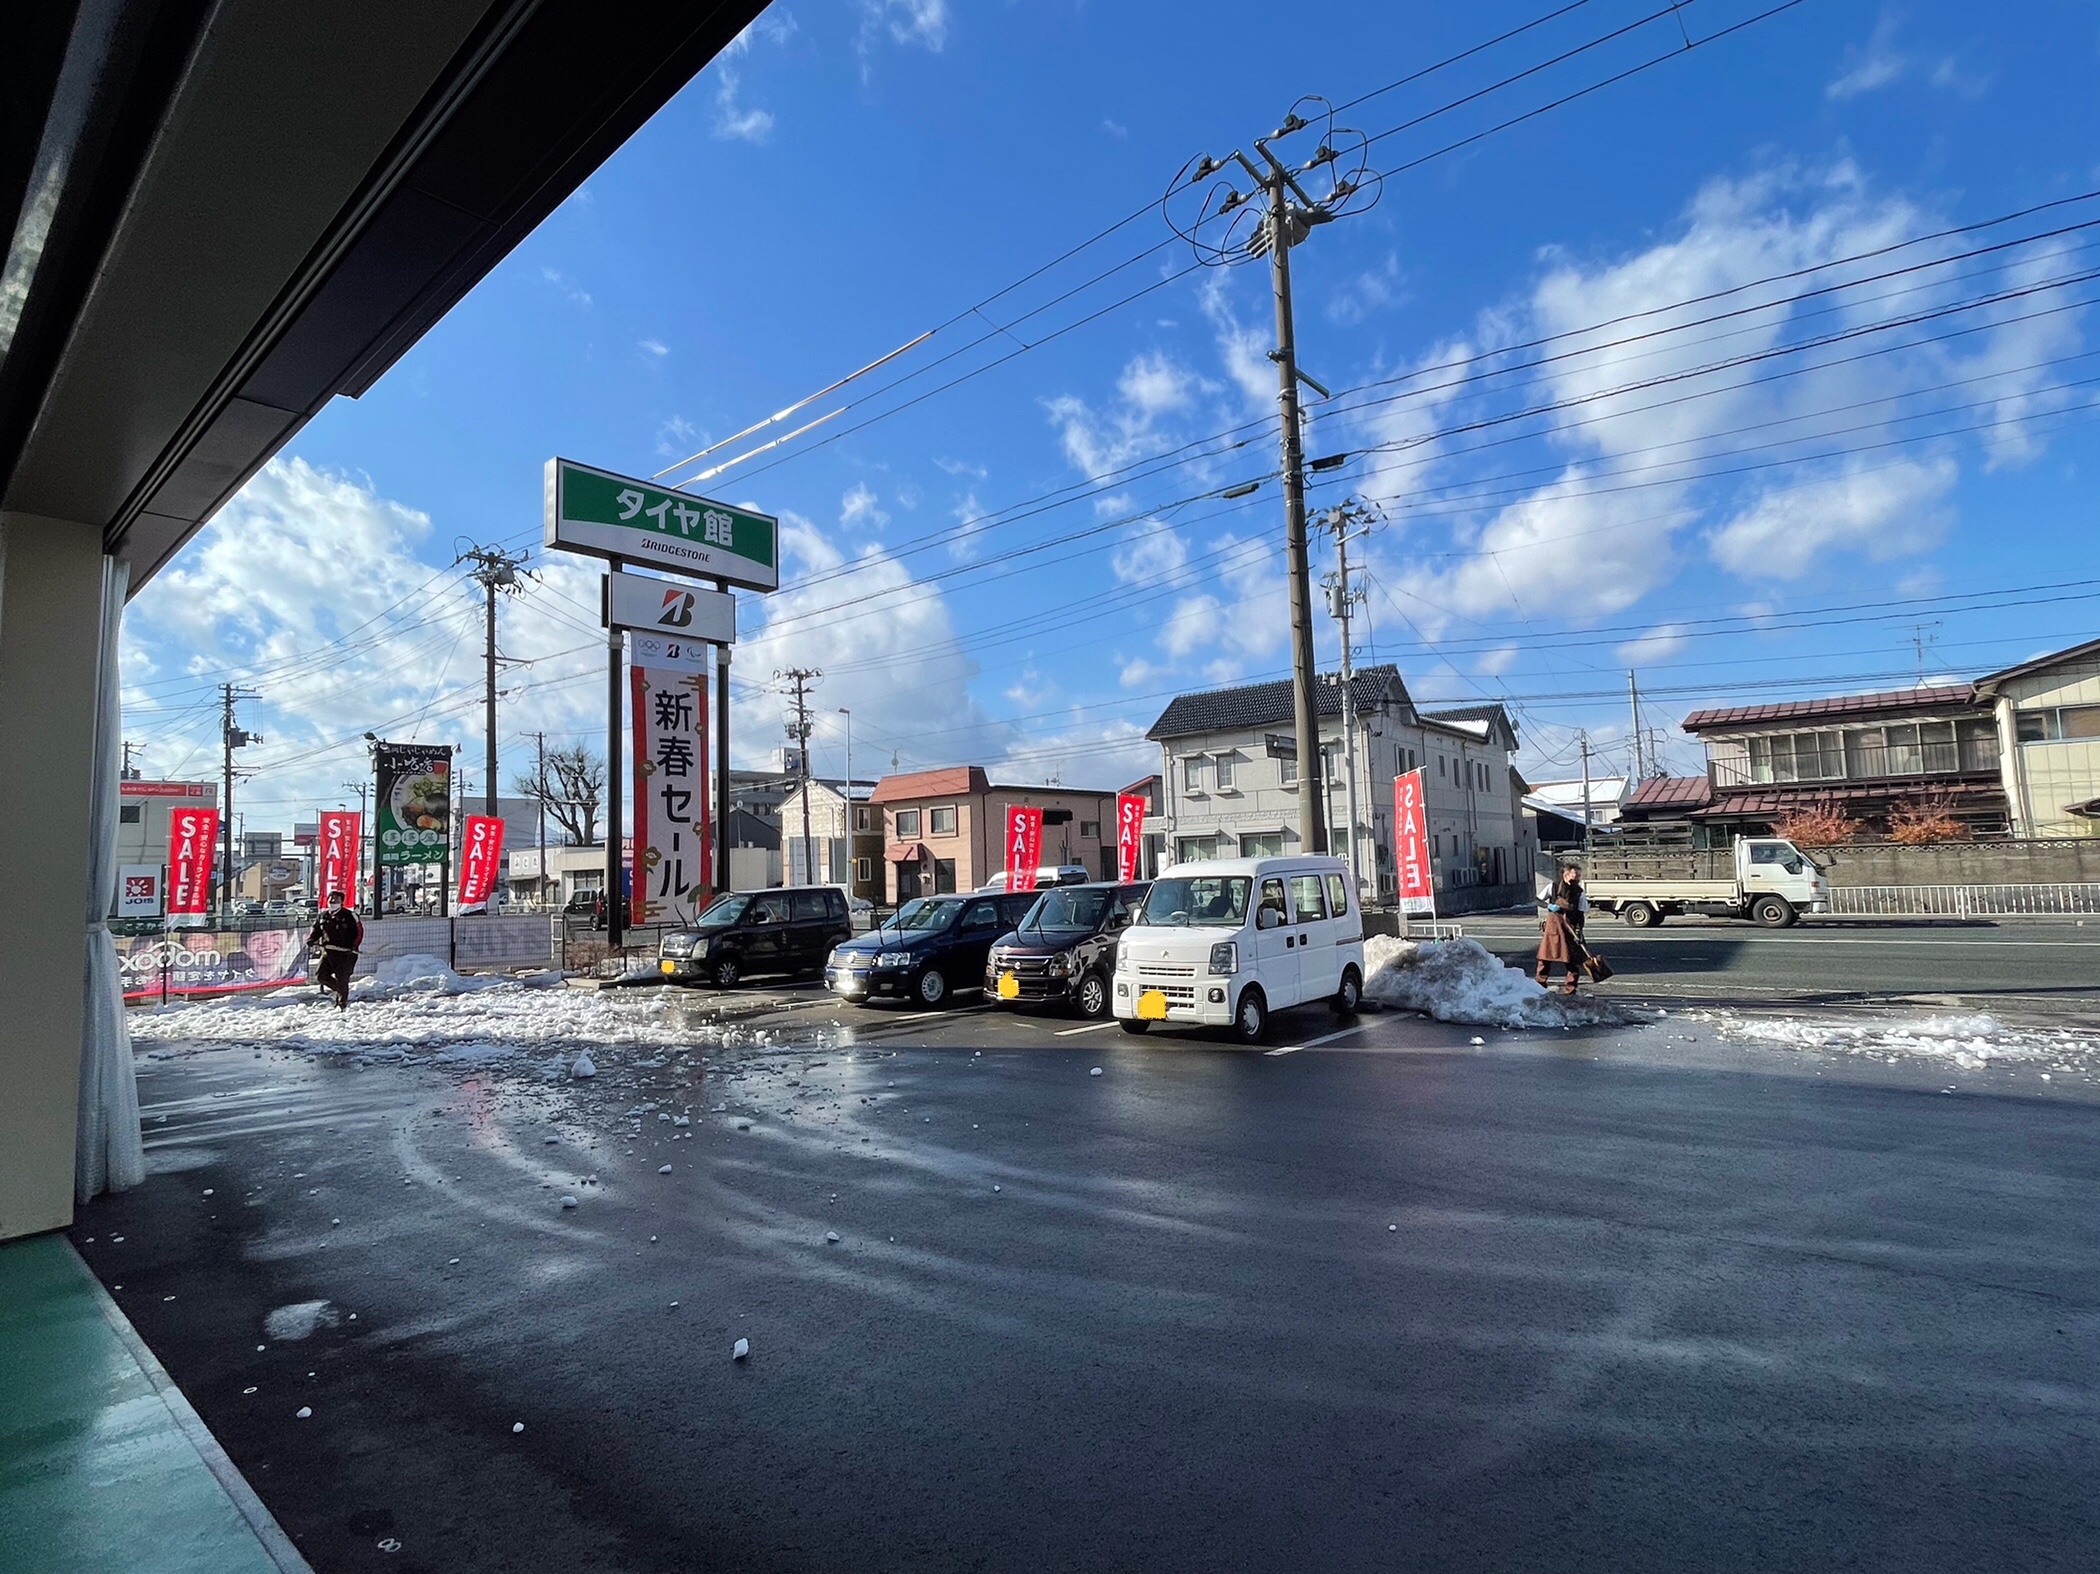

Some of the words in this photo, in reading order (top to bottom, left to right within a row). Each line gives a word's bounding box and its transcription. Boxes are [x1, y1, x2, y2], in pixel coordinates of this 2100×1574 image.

[615, 488, 733, 547] タイヤ館
[641, 538, 710, 562] BRIDGESTONE
[655, 689, 695, 897] 新春セール
[176, 816, 196, 907] SALE
[326, 819, 341, 897] SALE
[464, 822, 486, 898] SALE
[1012, 813, 1026, 891] SALE
[1120, 803, 1133, 882] SALE
[125, 897, 154, 905] JOIS
